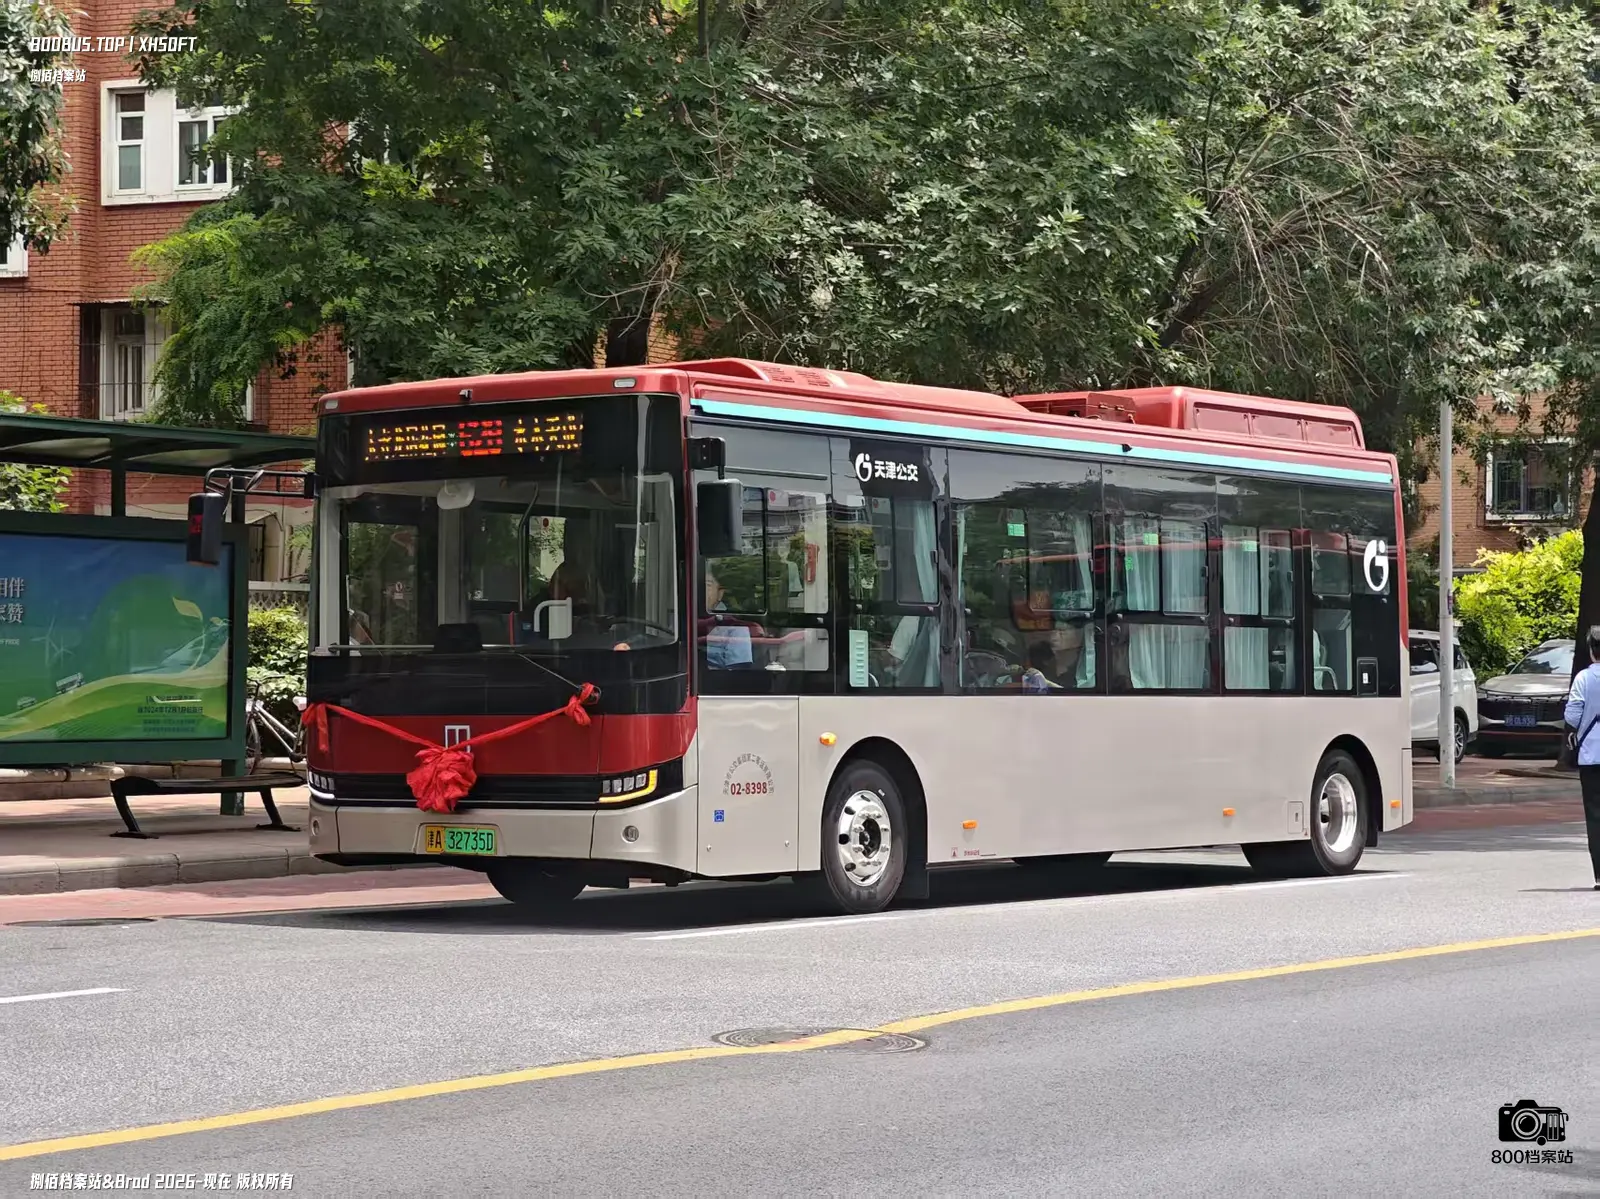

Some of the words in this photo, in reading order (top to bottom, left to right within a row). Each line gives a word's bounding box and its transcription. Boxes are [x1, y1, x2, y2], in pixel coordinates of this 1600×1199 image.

[874, 460, 919, 482] 天津公交
[730, 782, 768, 796] 02-8398
